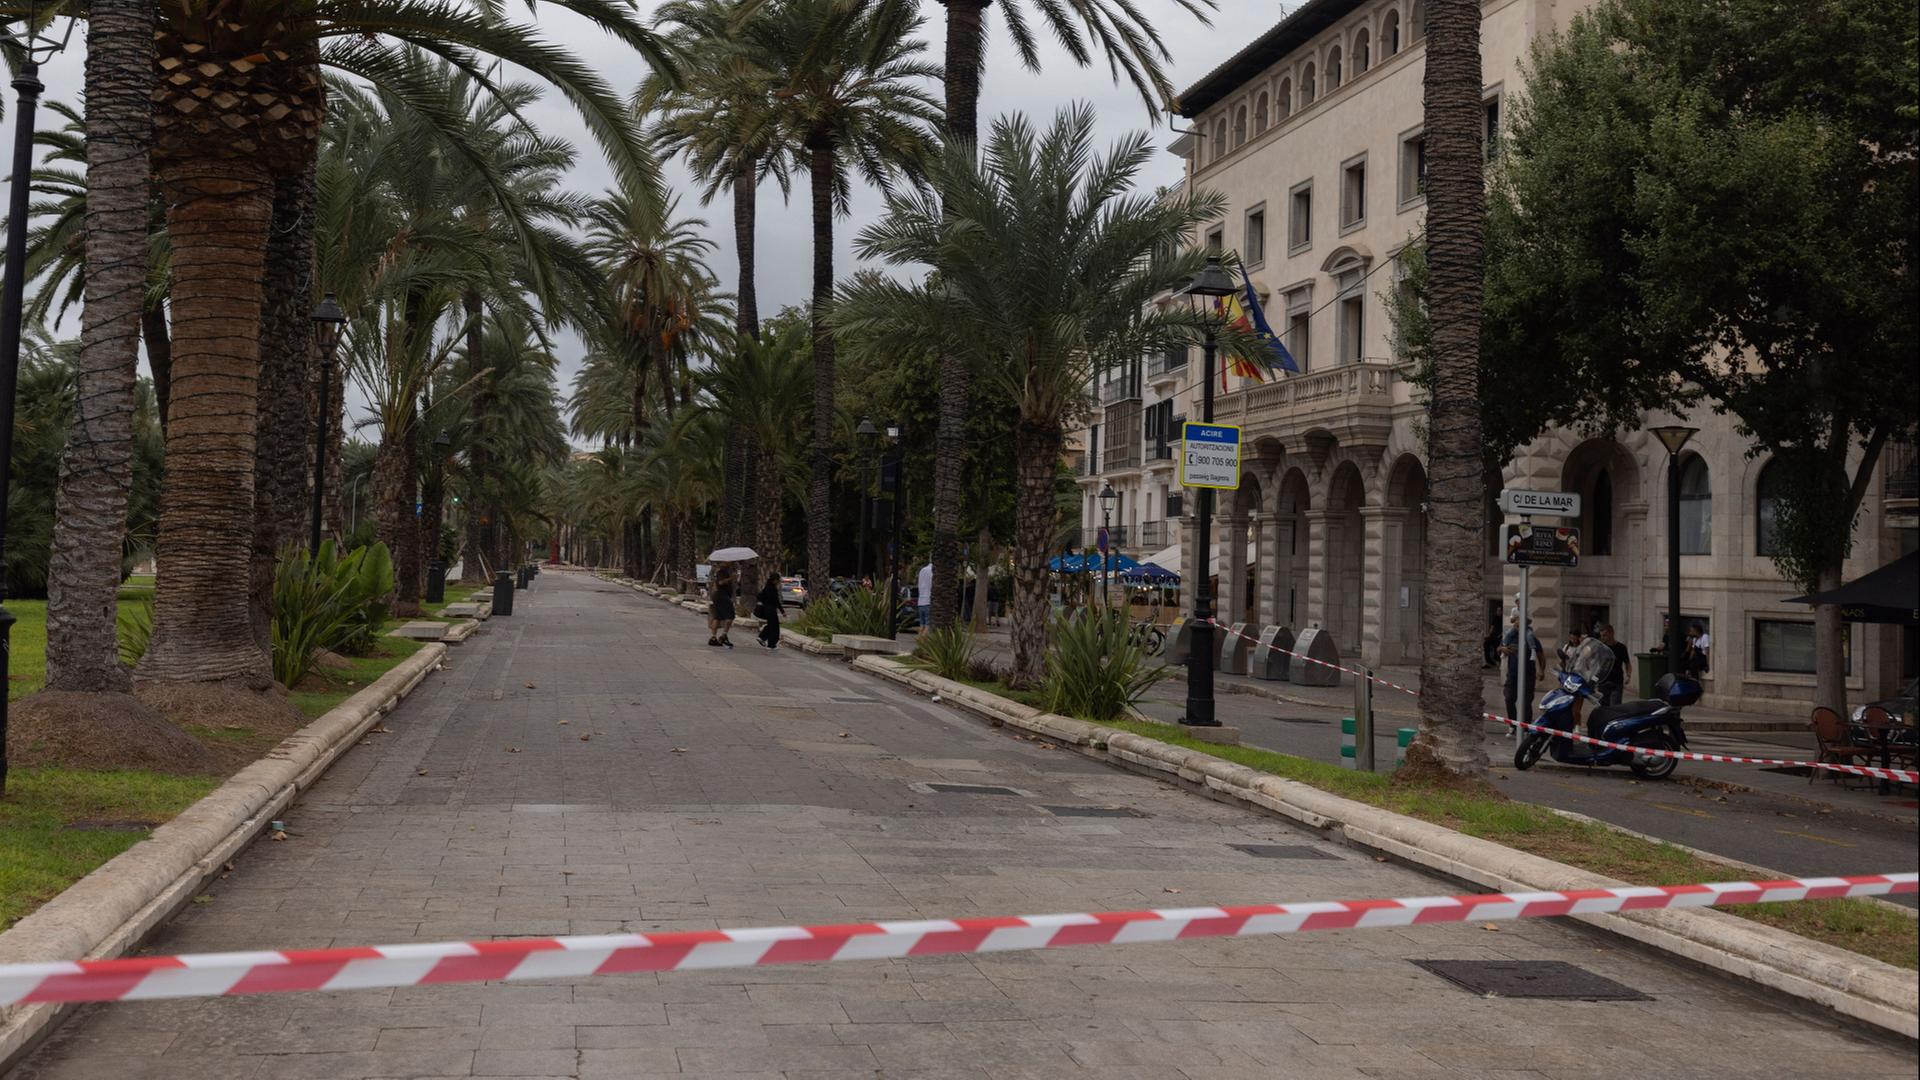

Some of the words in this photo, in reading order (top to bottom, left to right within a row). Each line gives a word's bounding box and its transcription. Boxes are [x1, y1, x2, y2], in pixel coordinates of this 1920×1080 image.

[1198, 456, 1210, 465] 900
[1212, 456, 1224, 466] 705
[1225, 458, 1237, 467] 900
[1513, 494, 1523, 504] C/
[1525, 495, 1537, 504] DE
[1539, 496, 1551, 505] LA
[1553, 496, 1573, 507] MAR
